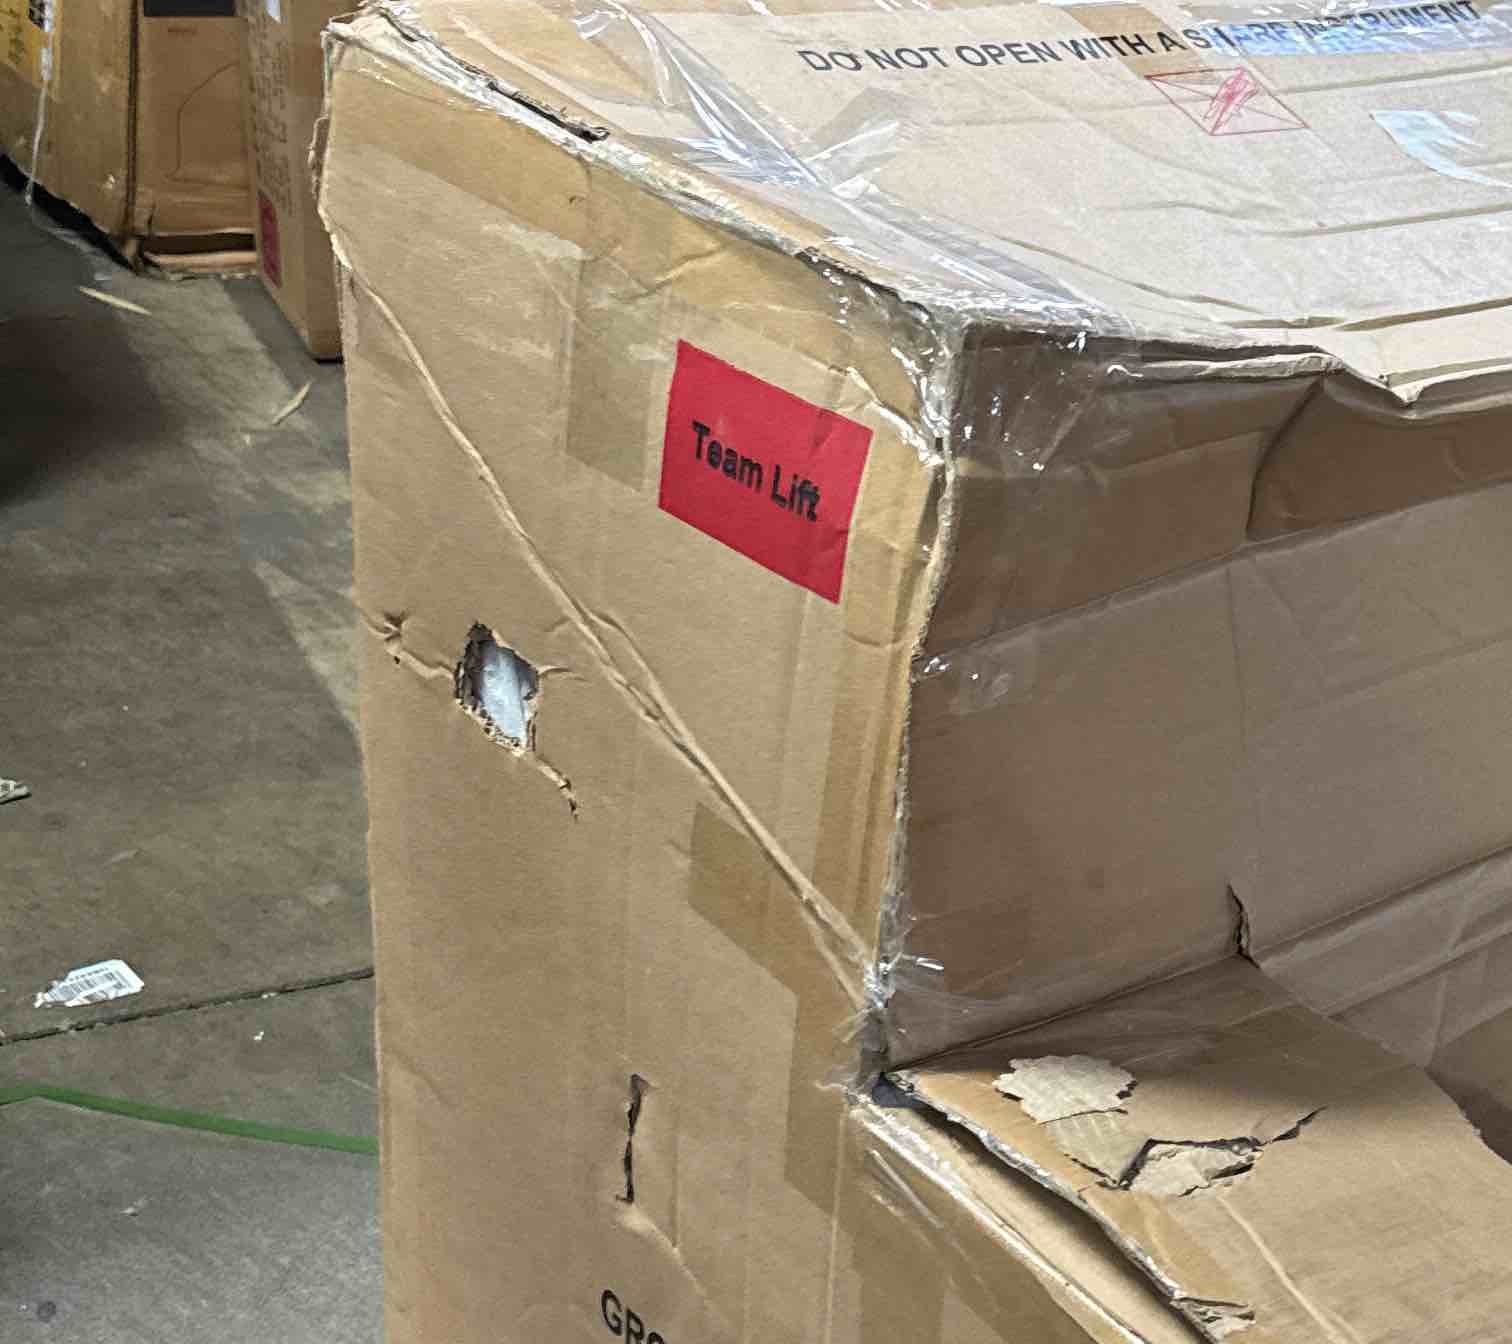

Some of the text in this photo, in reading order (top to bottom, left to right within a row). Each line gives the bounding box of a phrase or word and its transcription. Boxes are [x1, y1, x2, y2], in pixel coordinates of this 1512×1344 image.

[797, 49, 863, 72] DO
[864, 46, 951, 70] NOT
[954, 40, 1062, 68] OPEN
[1058, 32, 1150, 61] WITH
[1156, 31, 1189, 54] A
[1294, 0, 1483, 39] INSTRUMENT
[692, 419, 821, 523] Team Lift
